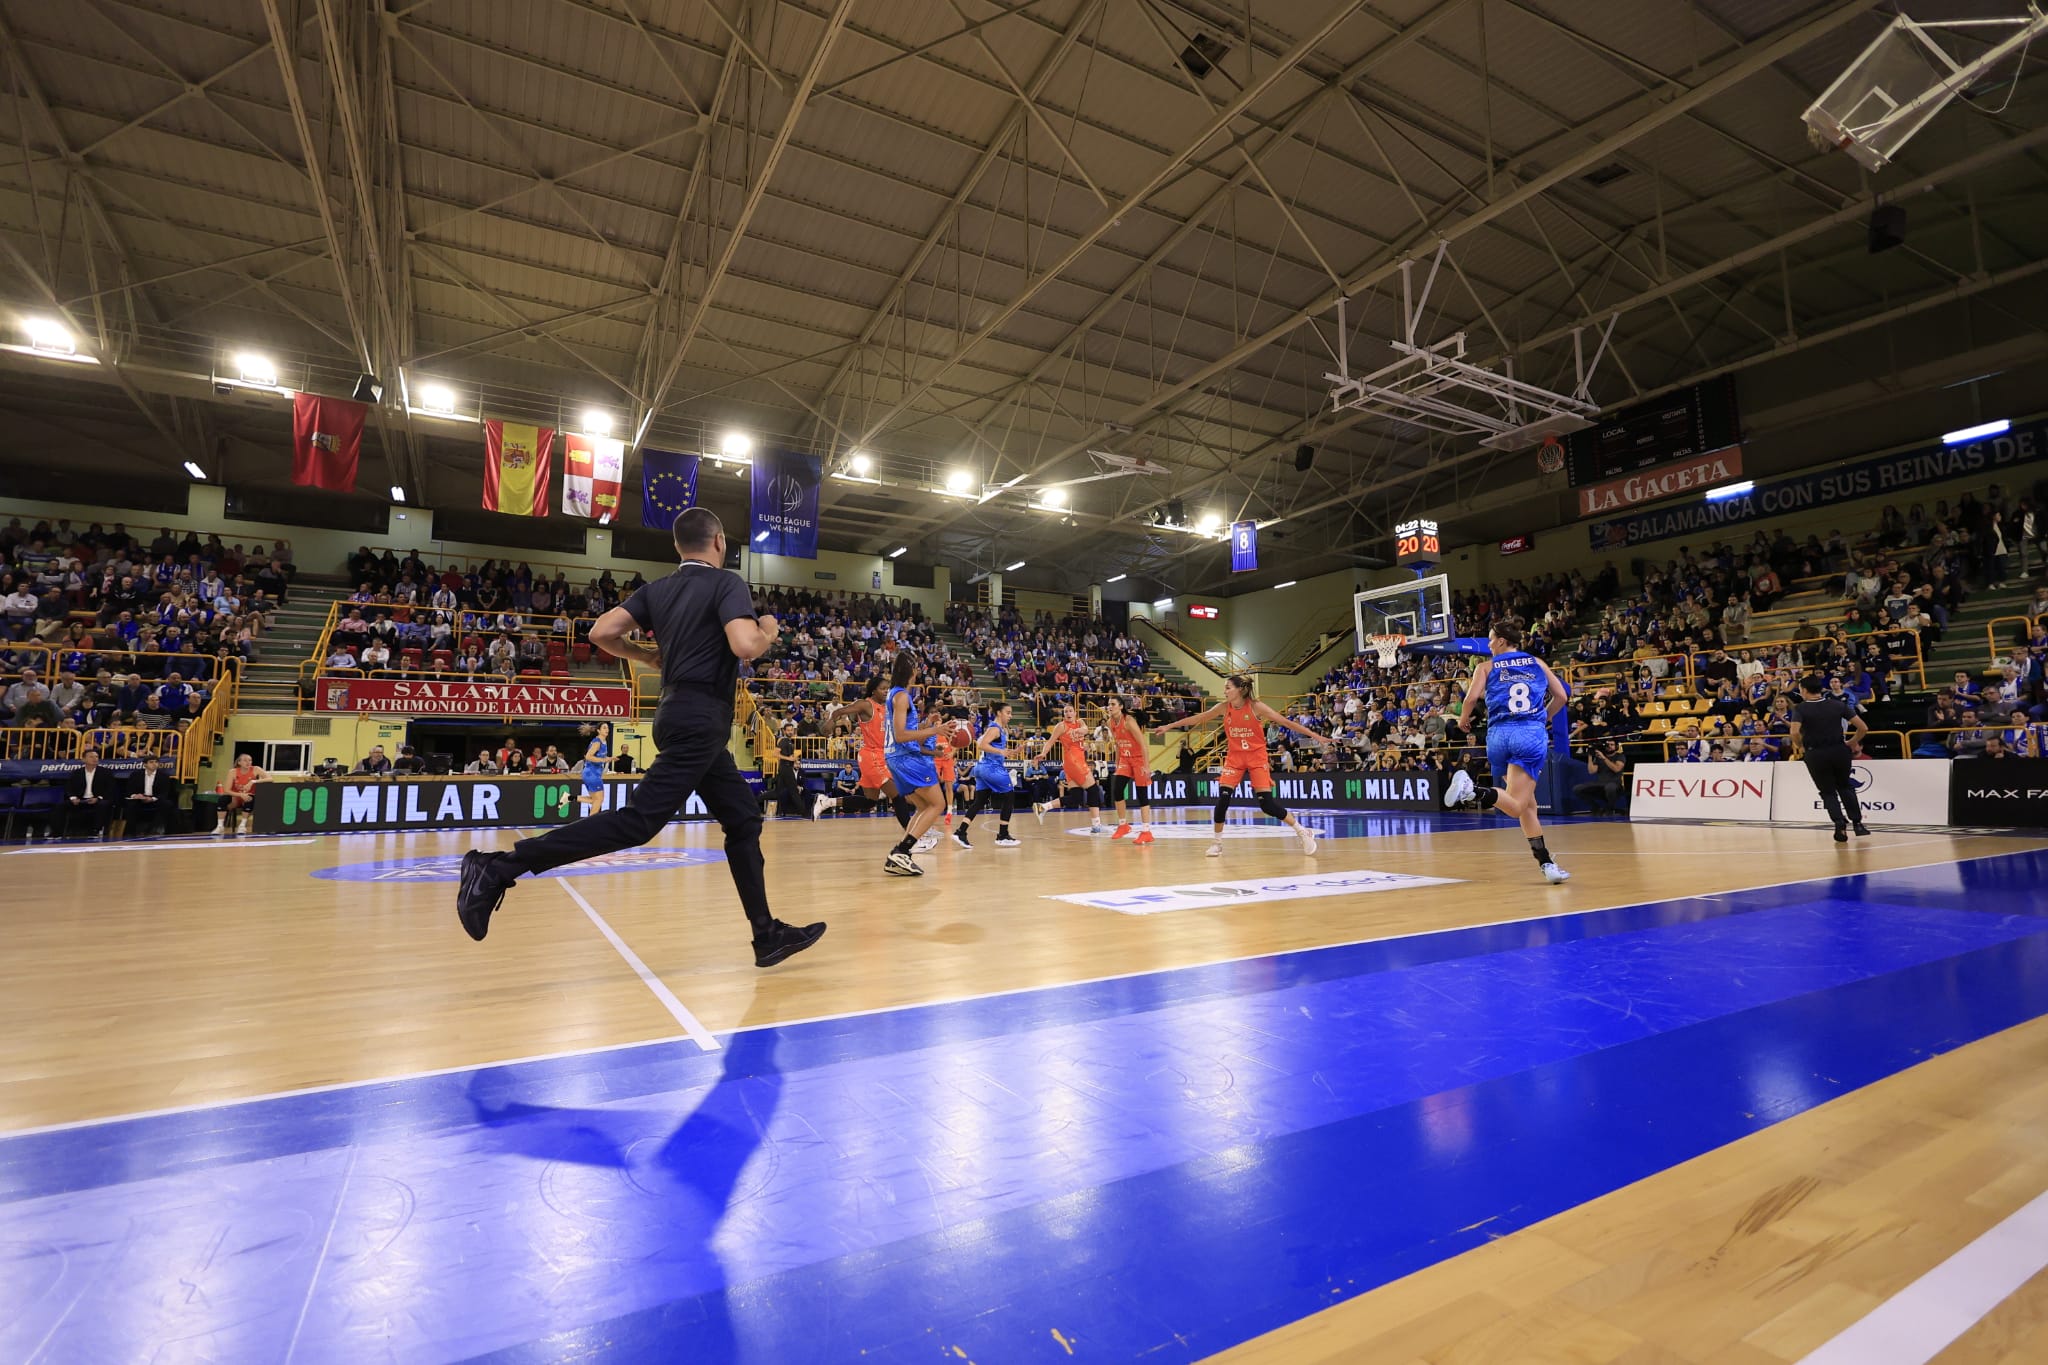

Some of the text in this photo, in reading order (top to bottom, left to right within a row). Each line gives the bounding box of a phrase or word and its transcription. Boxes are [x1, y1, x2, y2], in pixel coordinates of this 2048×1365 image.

[1602, 427, 1626, 439] LOCAL
[1586, 459, 1731, 513] LA GACETA
[1627, 495, 1756, 541] SALAMANCA
[1761, 481, 1814, 511] CON
[1819, 470, 1872, 500] SUS
[1877, 443, 1985, 488] REINAS
[1991, 431, 2036, 463] DE
[1395, 520, 1419, 534] 04:22
[1240, 532, 1249, 549] 8
[1398, 535, 1439, 556] 20 20
[1494, 658, 1534, 668] DELAERE
[393, 682, 599, 703] SALAMANCA
[1508, 682, 1530, 712] 8
[356, 697, 624, 716] PATRIMONIO DE LA HUMANIDAD
[1209, 780, 1254, 799] MAR
[1279, 779, 1333, 800] MILAR
[1366, 779, 1430, 801] MILAR
[1635, 778, 1765, 799] REVLON
[1967, 789, 2020, 799] MAX
[340, 784, 501, 824] MILAR
